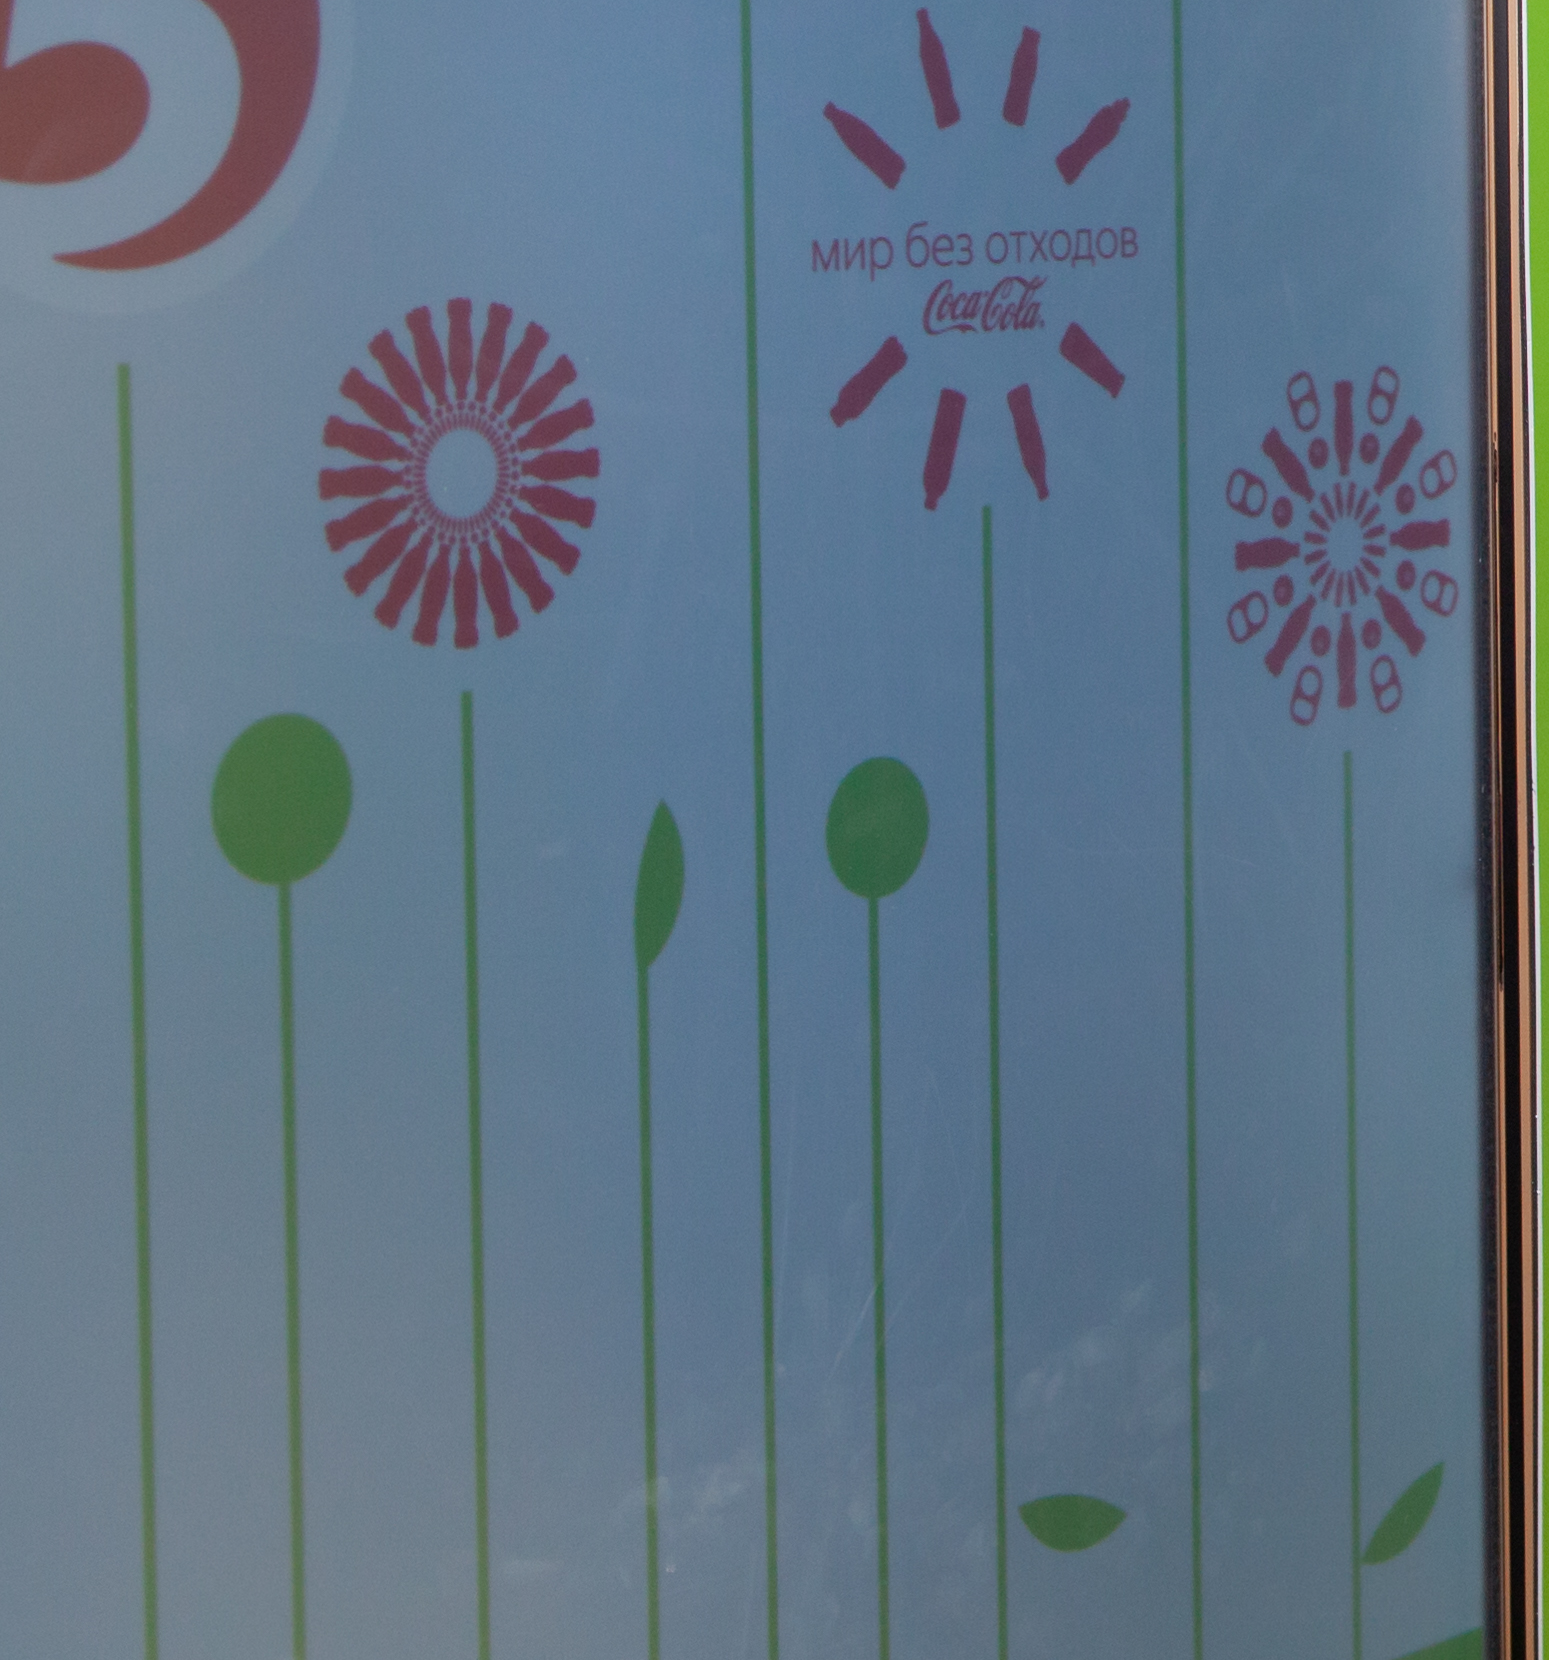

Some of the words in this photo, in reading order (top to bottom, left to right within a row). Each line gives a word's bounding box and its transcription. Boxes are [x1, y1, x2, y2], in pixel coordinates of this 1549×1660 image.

[811, 235, 894, 282] мир
[905, 221, 974, 268] без
[985, 226, 1139, 269] отходов
[922, 275, 1049, 335] Coca-Cola
